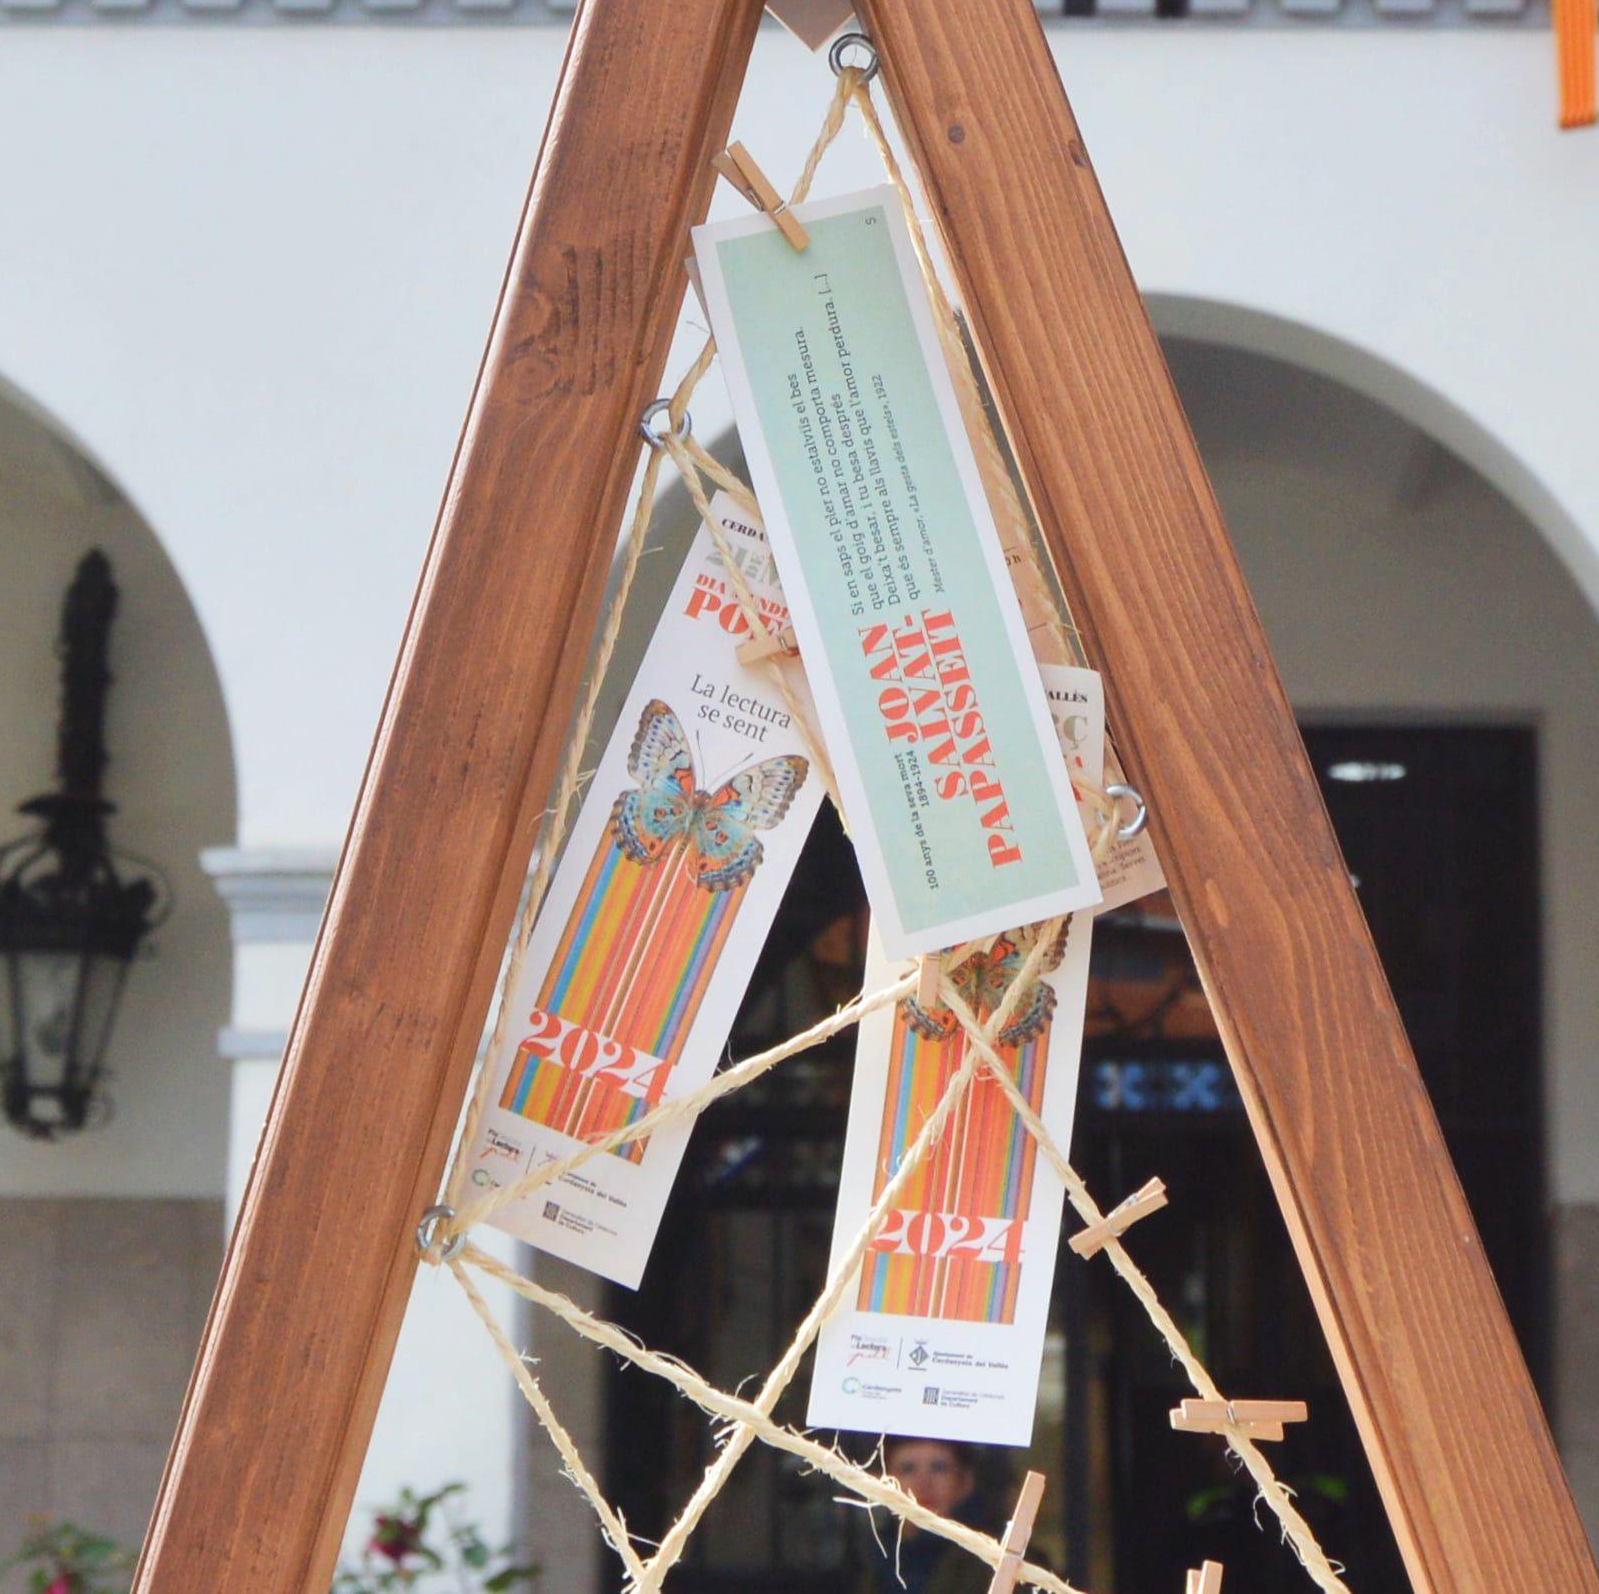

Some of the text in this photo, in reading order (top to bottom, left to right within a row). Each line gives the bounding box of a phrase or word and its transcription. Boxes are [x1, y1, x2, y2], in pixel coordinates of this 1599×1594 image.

[787, 373, 802, 400] bes
[838, 358, 862, 409] l’amor
[791, 399, 807, 414] el
[810, 385, 842, 456] comporta
[830, 390, 858, 448] després
[852, 409, 872, 438] que
[831, 454, 848, 481] no
[848, 447, 868, 485] besa
[860, 437, 882, 478] llavis
[816, 474, 831, 497] no
[858, 484, 871, 502] tu
[872, 477, 890, 498] als
[822, 499, 841, 528] pler
[881, 499, 905, 553] sempre
[829, 527, 844, 543] el
[851, 530, 873, 565] goig
[836, 544, 854, 577] saps
[859, 565, 874, 581] el
[897, 554, 910, 571] és
[696, 573, 727, 595] DIA
[847, 577, 860, 599] en
[867, 582, 885, 611] que
[902, 573, 920, 601] que
[850, 599, 865, 616] Si
[857, 623, 919, 745] JOAN
[1045, 689, 1089, 704] ALLÈS
[690, 673, 792, 729] La lectura
[891, 609, 970, 801] SALVAT-
[697, 702, 769, 744] se sent
[918, 608, 1023, 870] PAPASSEIT
[904, 748, 930, 808] 1894-1924
[893, 751, 940, 890] 100 anys de la seva mort
[518, 1010, 668, 1104] 2024
[867, 1207, 1025, 1265] 2024
